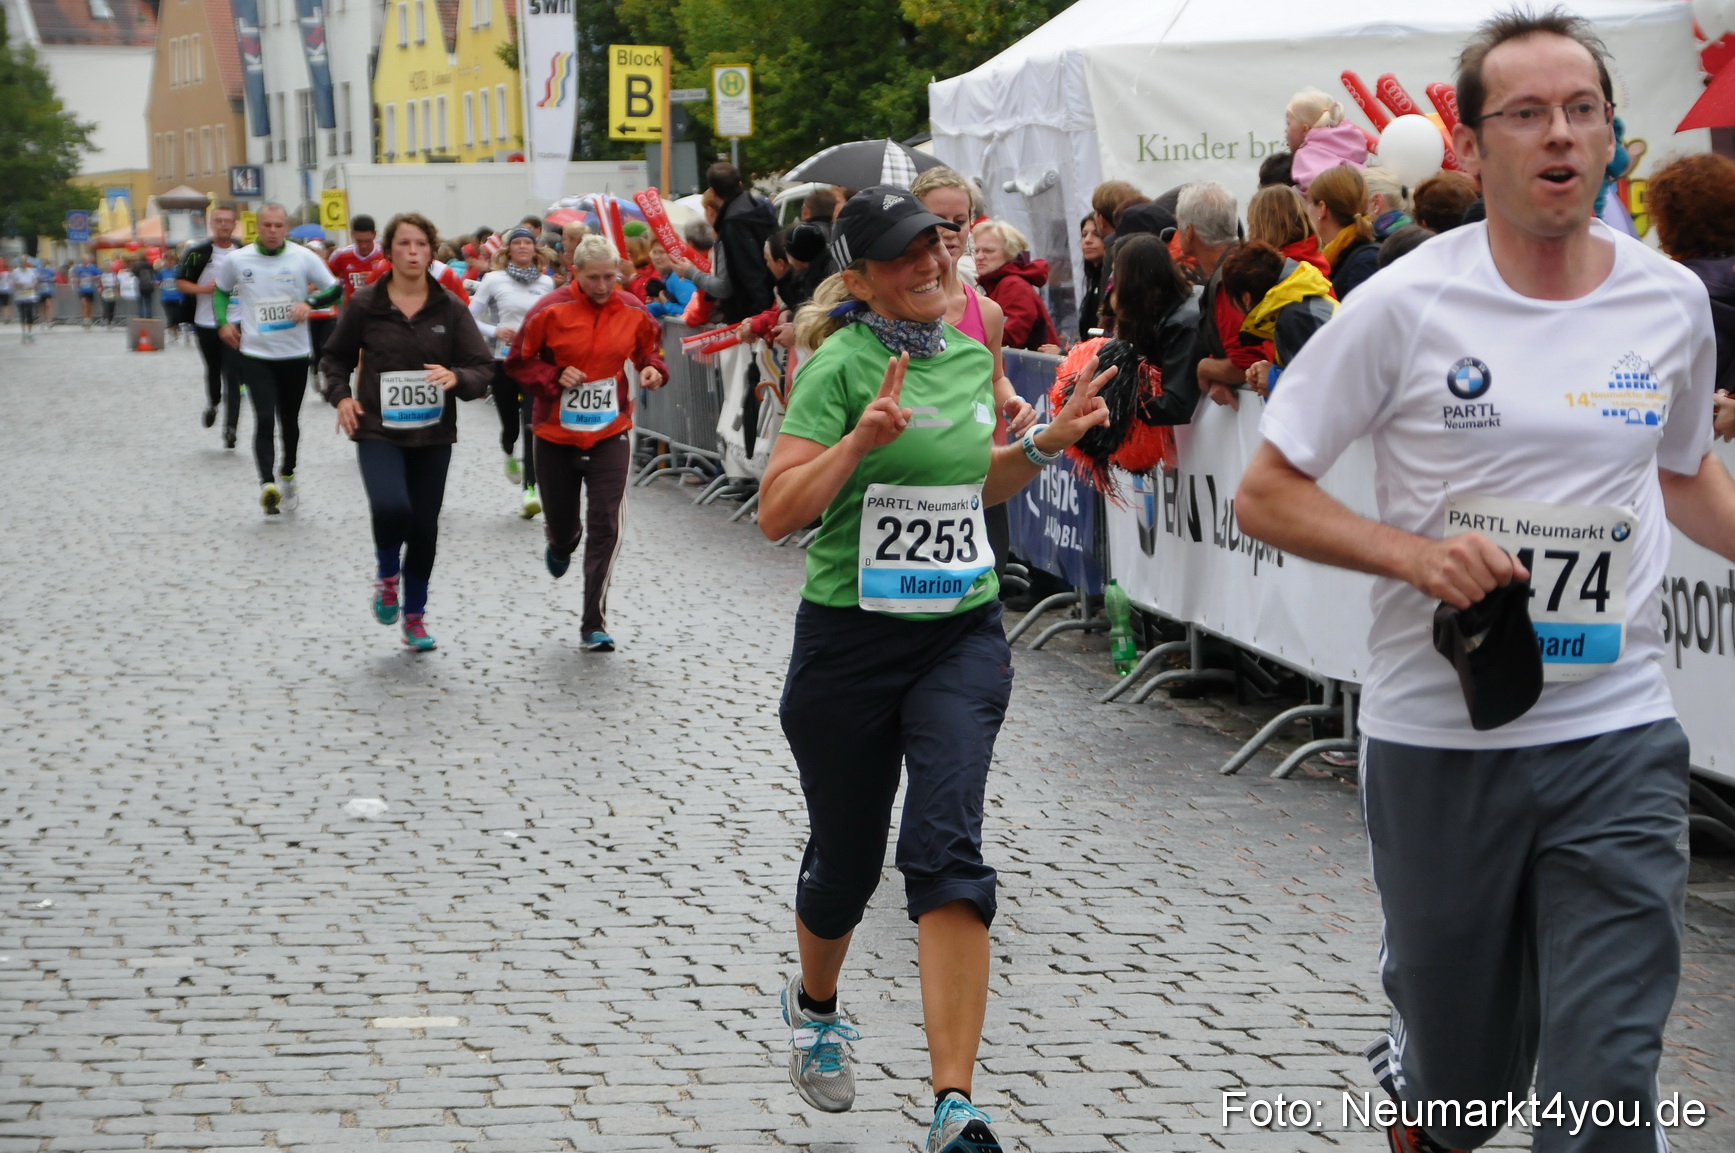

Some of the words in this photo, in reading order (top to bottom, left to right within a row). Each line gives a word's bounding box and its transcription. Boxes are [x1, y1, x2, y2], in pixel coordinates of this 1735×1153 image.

[617, 49, 662, 67] Block
[626, 73, 654, 118] B
[1136, 131, 1240, 163] Kinder
[326, 200, 341, 222] C
[882, 196, 905, 211] adidas
[388, 384, 439, 407] 2053
[567, 388, 612, 410] 2054
[1564, 391, 1597, 408] 14.
[1443, 402, 1501, 419] PARTL
[1444, 417, 1502, 430] Neumarkt
[866, 496, 914, 511] PARTL
[917, 497, 969, 512] Neumarkt
[1448, 509, 1511, 534] PARTL
[1515, 519, 1606, 541] Neumarkt
[875, 515, 979, 564] 2253
[864, 557, 871, 567] D
[900, 575, 962, 595] Marion
